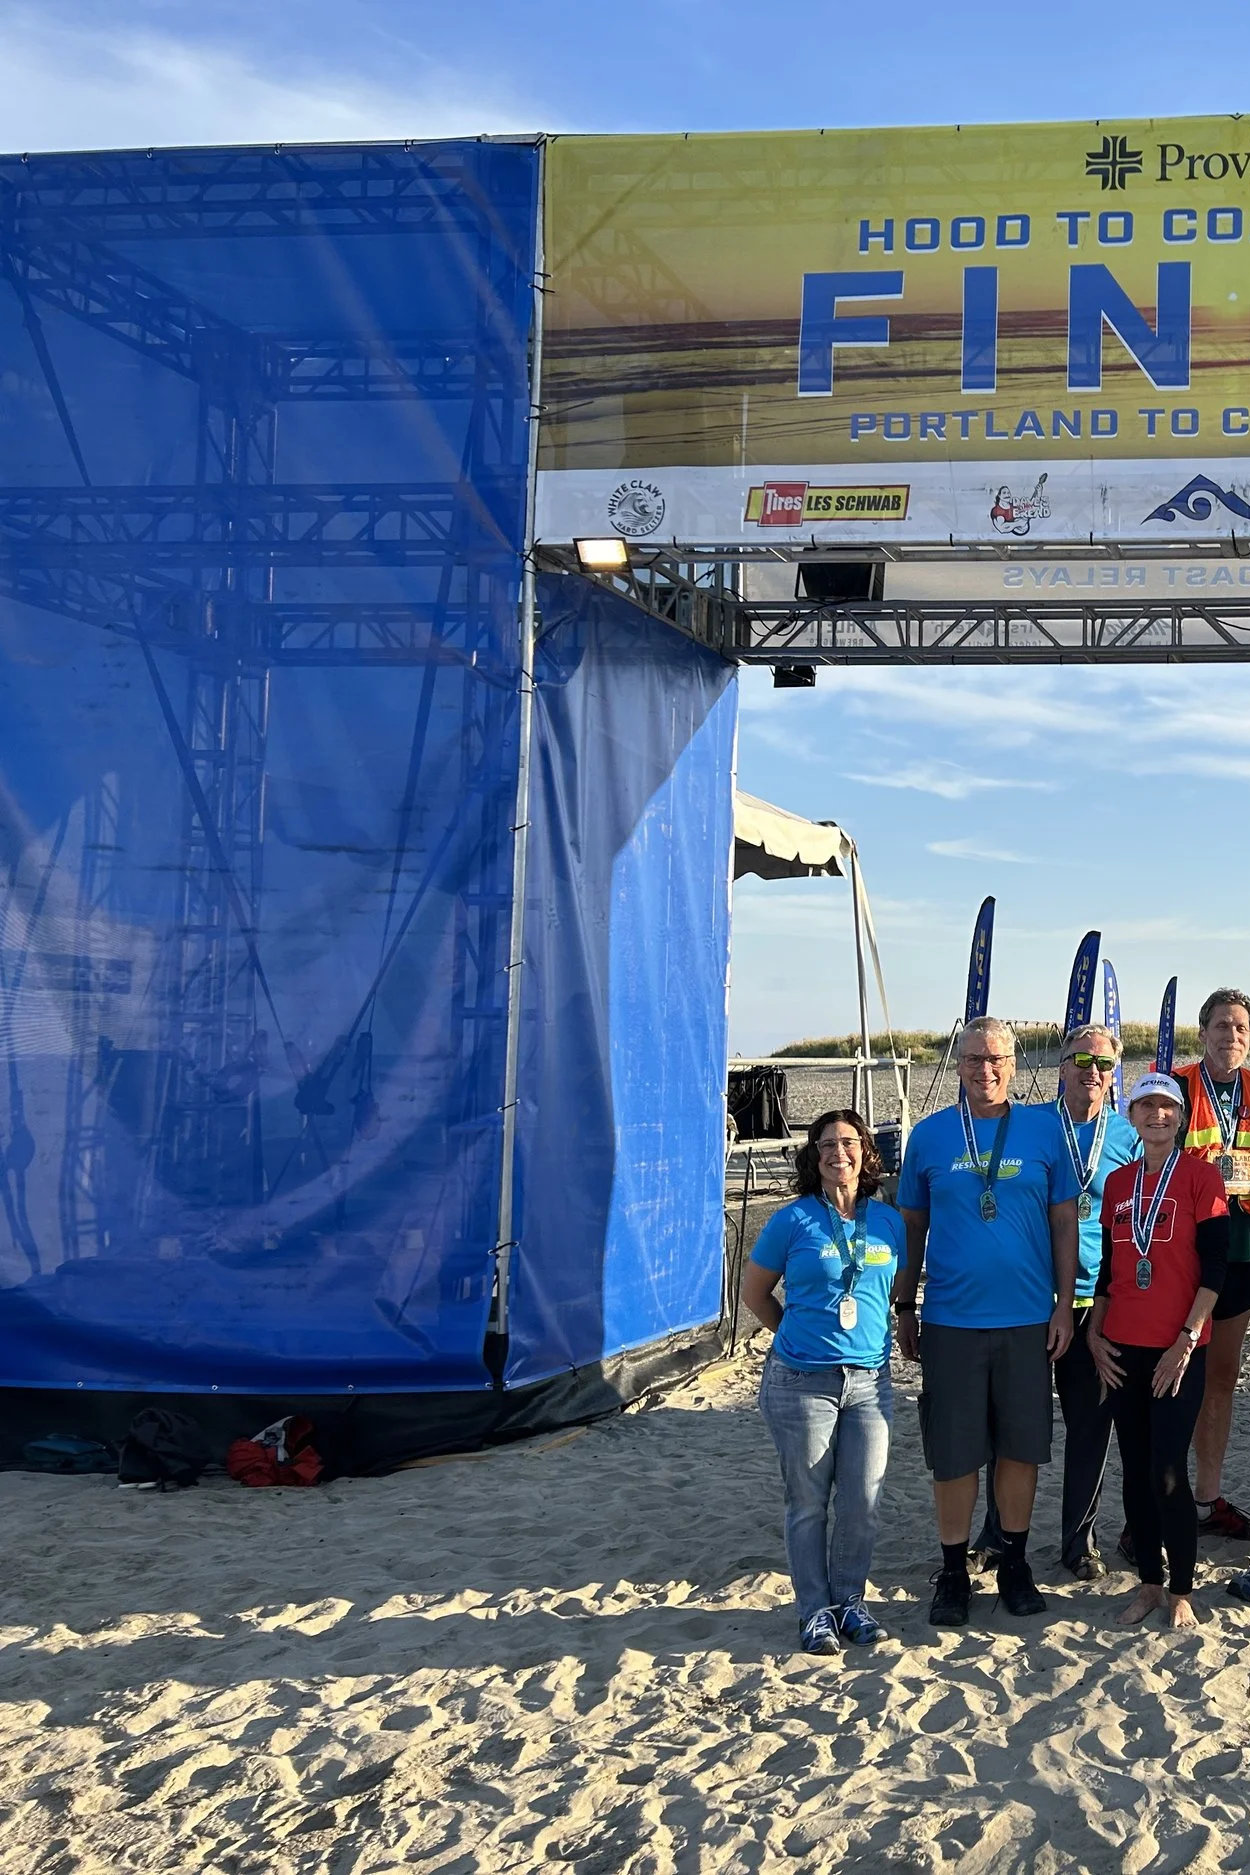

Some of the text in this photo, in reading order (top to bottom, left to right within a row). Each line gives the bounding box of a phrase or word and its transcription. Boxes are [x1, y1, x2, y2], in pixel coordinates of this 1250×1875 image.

[858, 214, 1031, 255] HOOD
[1056, 210, 1134, 249] TO
[850, 409, 1118, 442] PORTLAND
[1138, 408, 1200, 438] TO
[607, 480, 662, 518] WHITE CLAW
[765, 488, 901, 515] Tires LES SCHWAB
[616, 522, 638, 534] HARD
